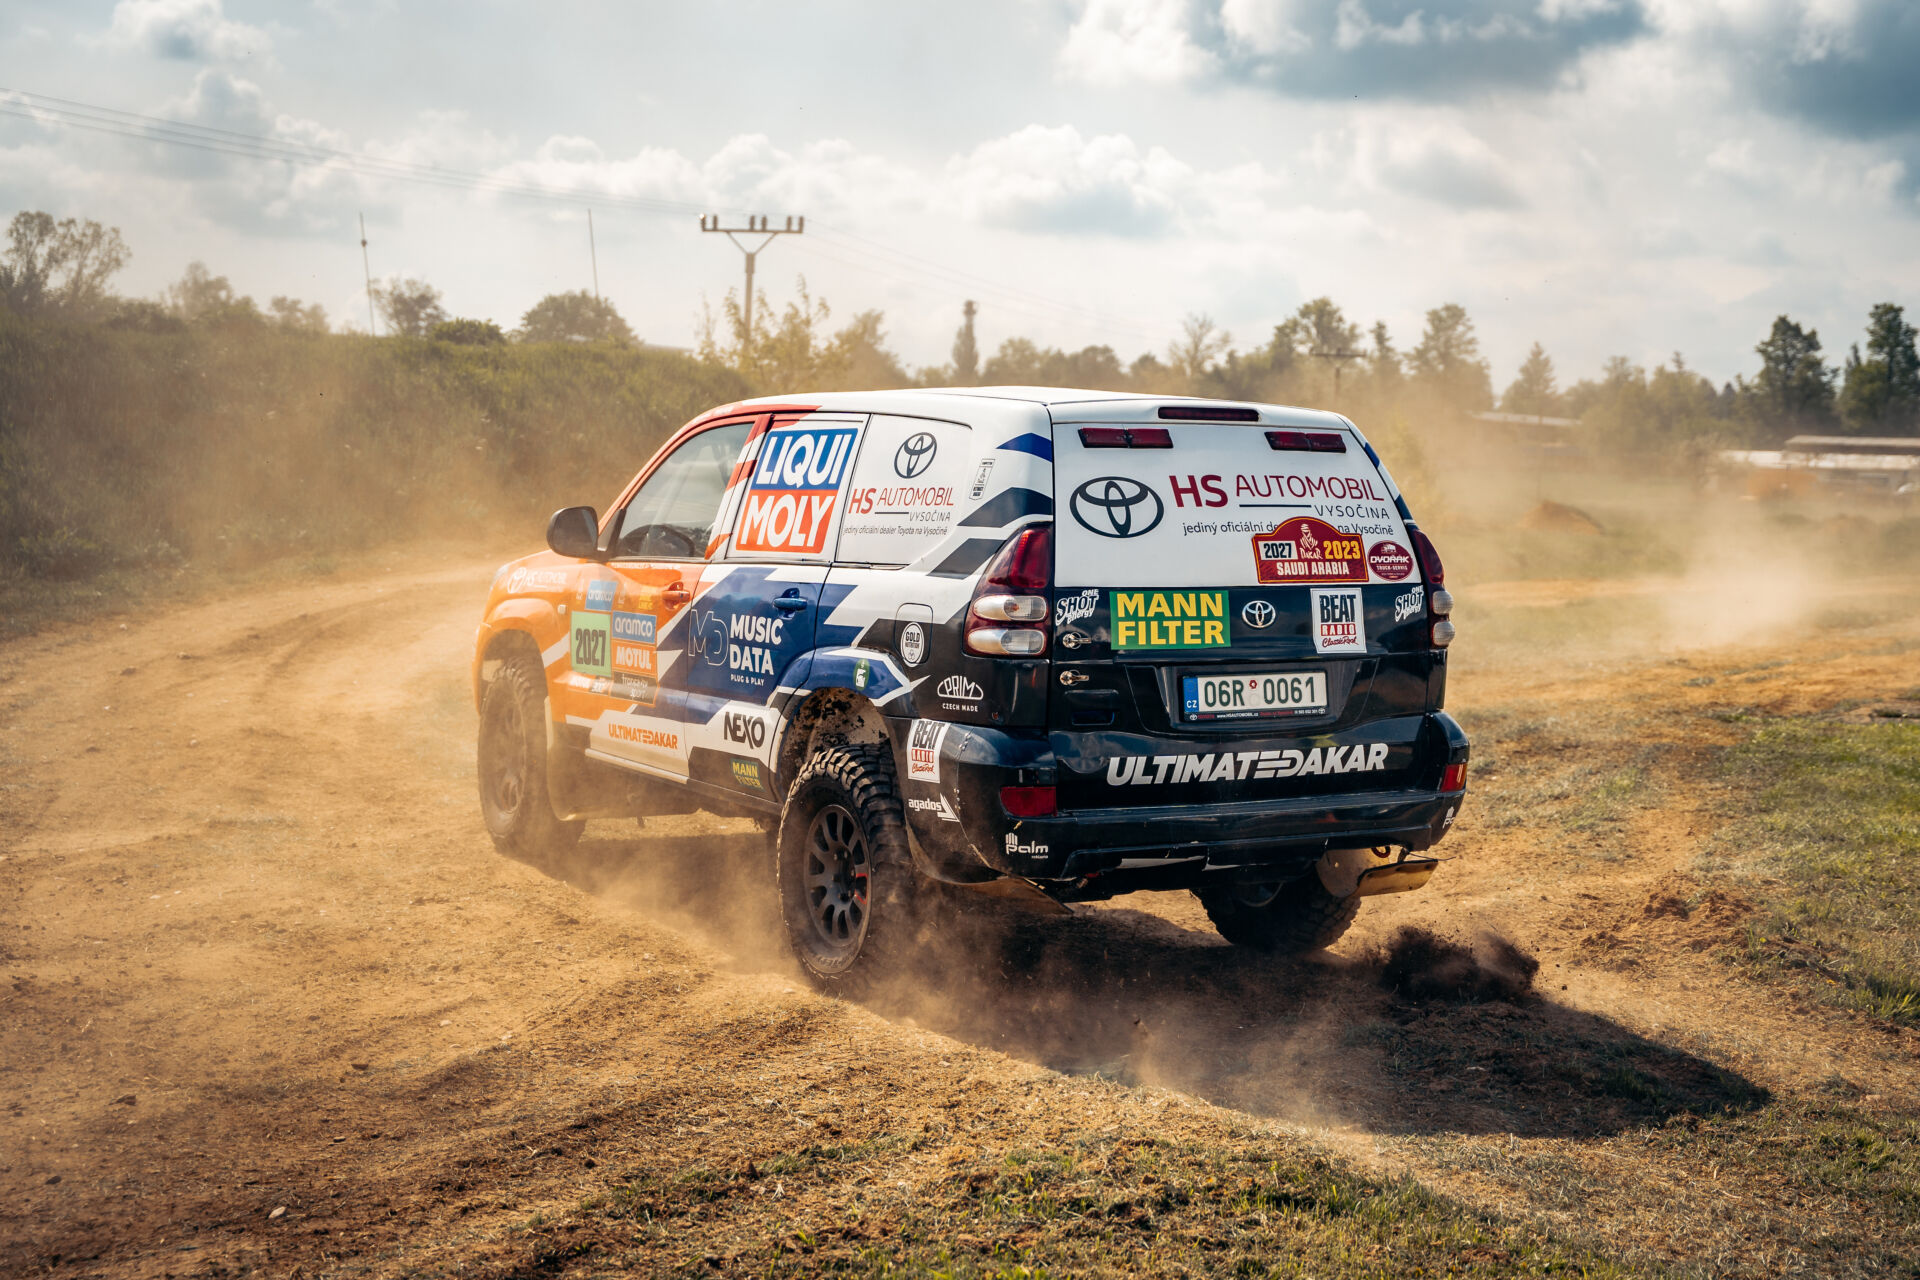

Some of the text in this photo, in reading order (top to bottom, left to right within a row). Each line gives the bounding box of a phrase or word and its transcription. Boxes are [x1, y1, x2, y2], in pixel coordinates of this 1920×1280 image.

[755, 432, 853, 489] LIQUI
[847, 487, 954, 515] HS AUTOMOBIL
[1169, 474, 1385, 508] HS AUTOMOBIL
[740, 493, 836, 548] MOLY
[909, 509, 951, 522] VYSOČINA
[1314, 503, 1390, 520] VYSOČINA
[880, 525, 896, 535] dealer
[897, 525, 914, 537] Toyota
[1182, 521, 1217, 537] jediný
[1220, 521, 1264, 533] oficiální
[1351, 522, 1394, 536] Vysočině
[1263, 540, 1361, 560] 2027 2023
[1276, 561, 1350, 576] SAUDI ARABIA
[587, 589, 613, 603] aramco
[1081, 588, 1099, 597] ONE
[1055, 595, 1099, 626] SHOT
[1116, 592, 1223, 618] MANN
[1319, 594, 1356, 623] BEAT
[1394, 591, 1424, 622] SHOT
[614, 617, 653, 637] aramco
[729, 613, 784, 645] MUSIC
[905, 631, 920, 643] GOLD
[1117, 620, 1225, 646] FILTER
[1322, 624, 1355, 636] RADIO
[575, 627, 607, 667] 2027
[615, 646, 652, 670] MOTUL
[729, 643, 774, 675] DATA
[730, 673, 764, 687] PLUG & PLAY
[943, 675, 976, 699] PRIM
[1203, 676, 1316, 708] 06R 0061
[942, 702, 978, 712] CZECH MADE
[1186, 700, 1198, 709] CZ
[723, 711, 766, 750] NEXO
[912, 720, 946, 750] BEAT
[732, 761, 758, 778] MANN
[908, 798, 942, 812] agados
